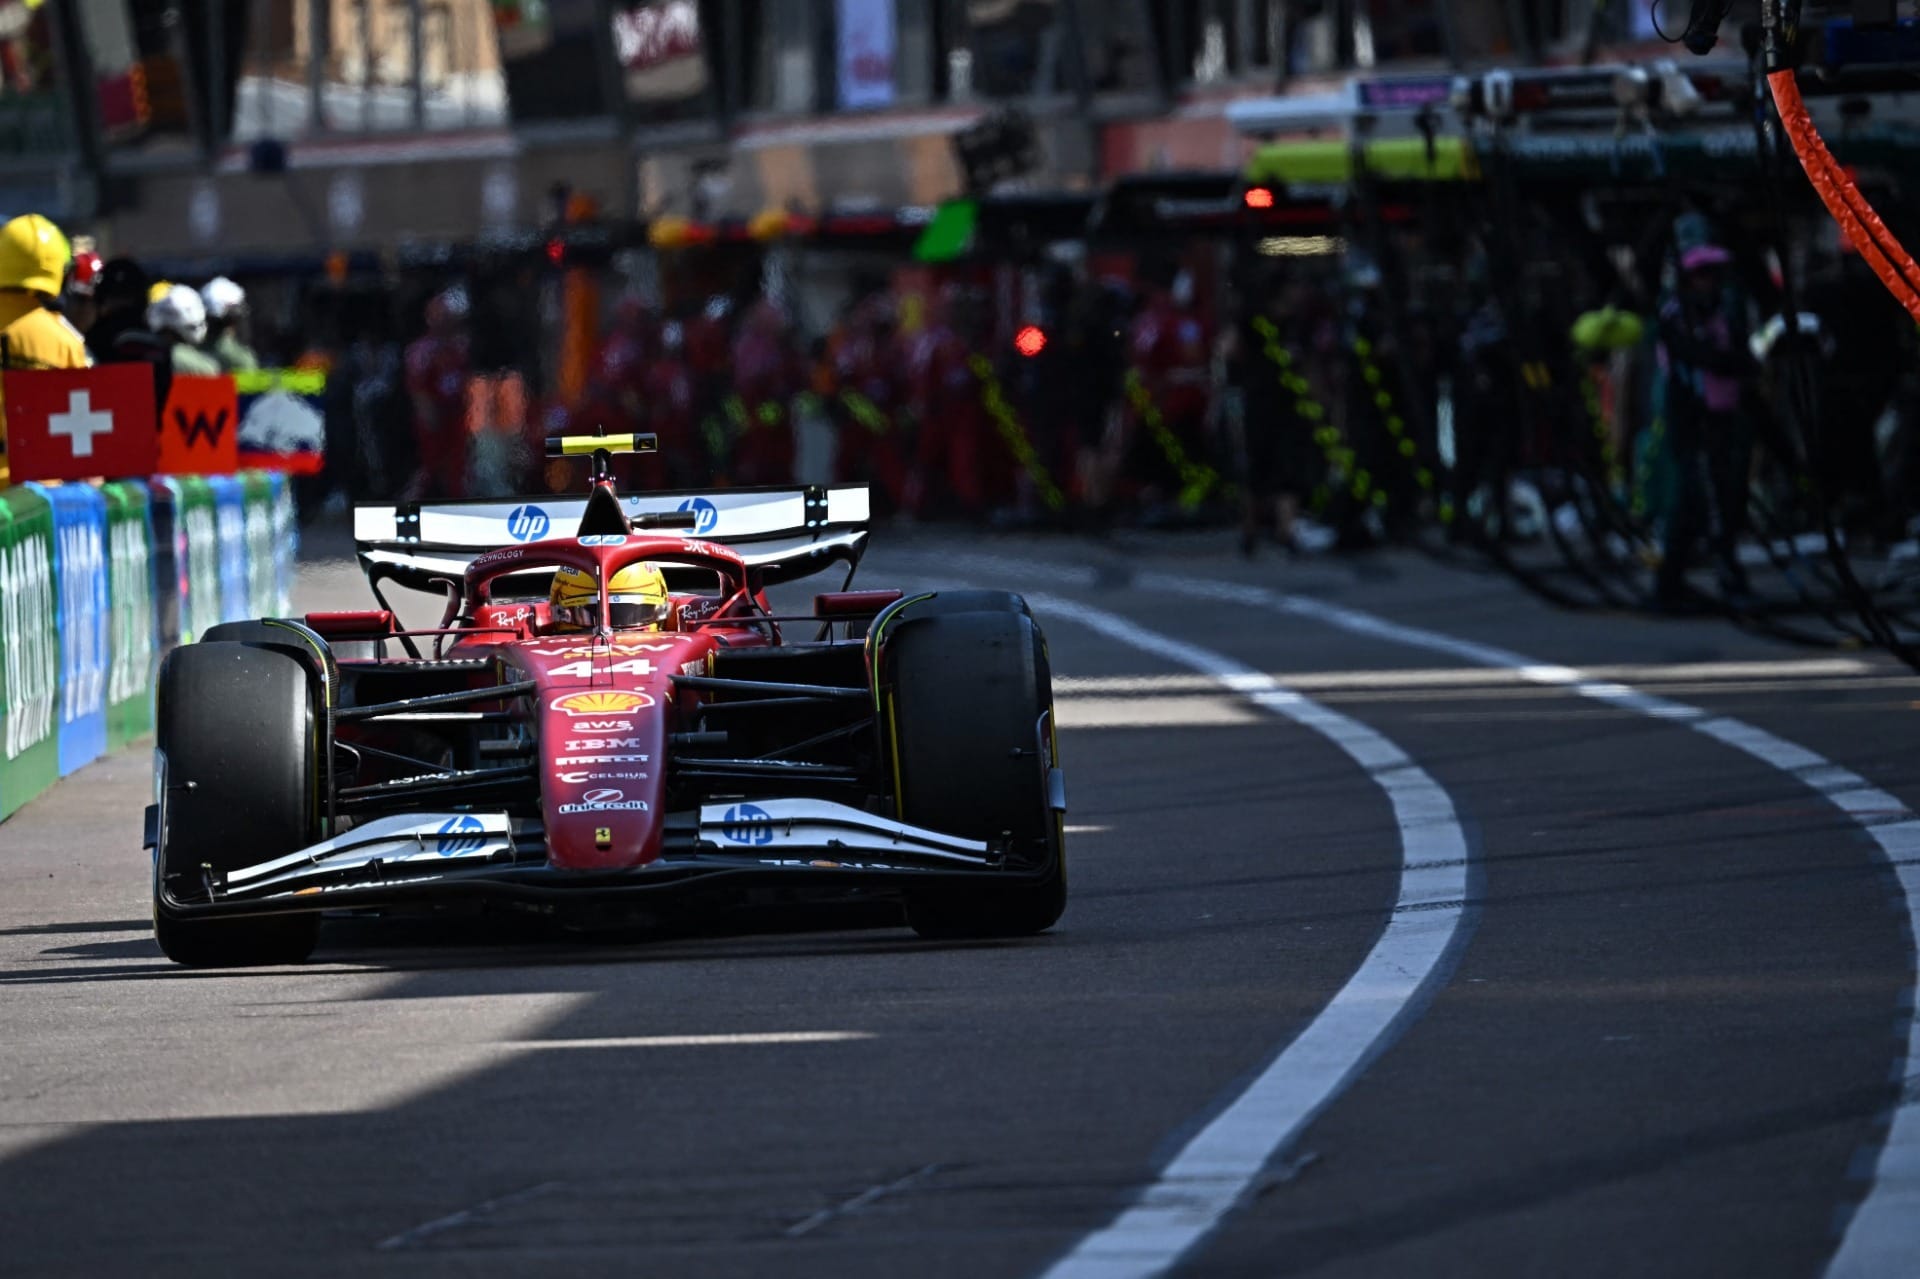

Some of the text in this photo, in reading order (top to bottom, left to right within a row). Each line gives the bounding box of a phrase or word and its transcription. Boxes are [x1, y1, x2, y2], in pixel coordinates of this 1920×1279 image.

[173, 409, 229, 449] W
[511, 504, 547, 542] hp
[546, 659, 659, 678] 44
[573, 720, 633, 732] aws
[565, 738, 641, 751] IBM
[559, 801, 649, 814] UniCredit
[440, 814, 484, 857] hp
[729, 803, 769, 846] hp
